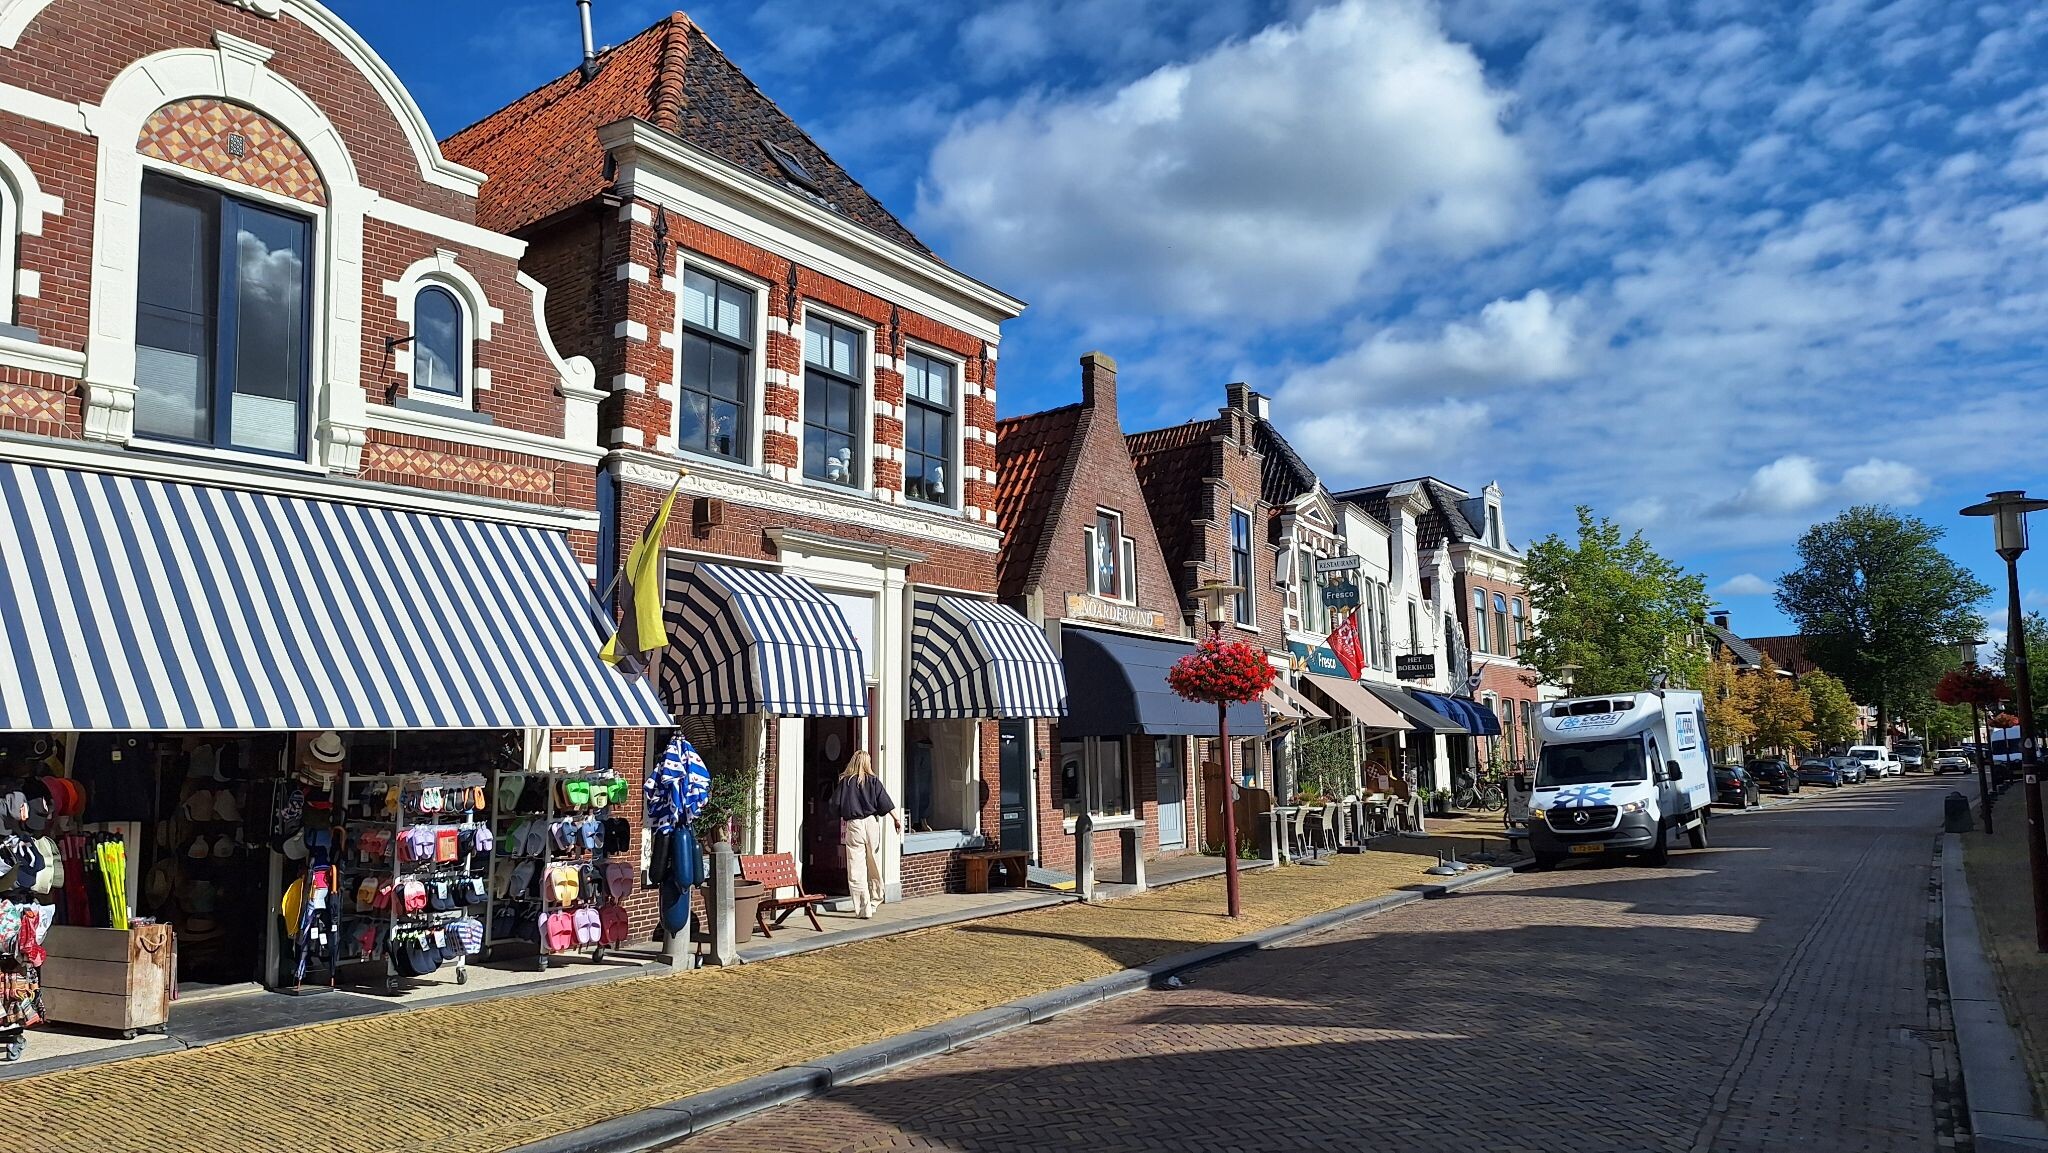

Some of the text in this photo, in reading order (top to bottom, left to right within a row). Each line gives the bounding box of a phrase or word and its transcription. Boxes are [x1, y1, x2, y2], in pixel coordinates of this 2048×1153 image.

[1319, 559, 1357, 569] RESTAURANT
[1326, 591, 1354, 599] Fresco
[1082, 600, 1153, 626] NOARDERWIND
[1318, 653, 1337, 669] Fresco
[1397, 663, 1434, 671] BOEKHUIS
